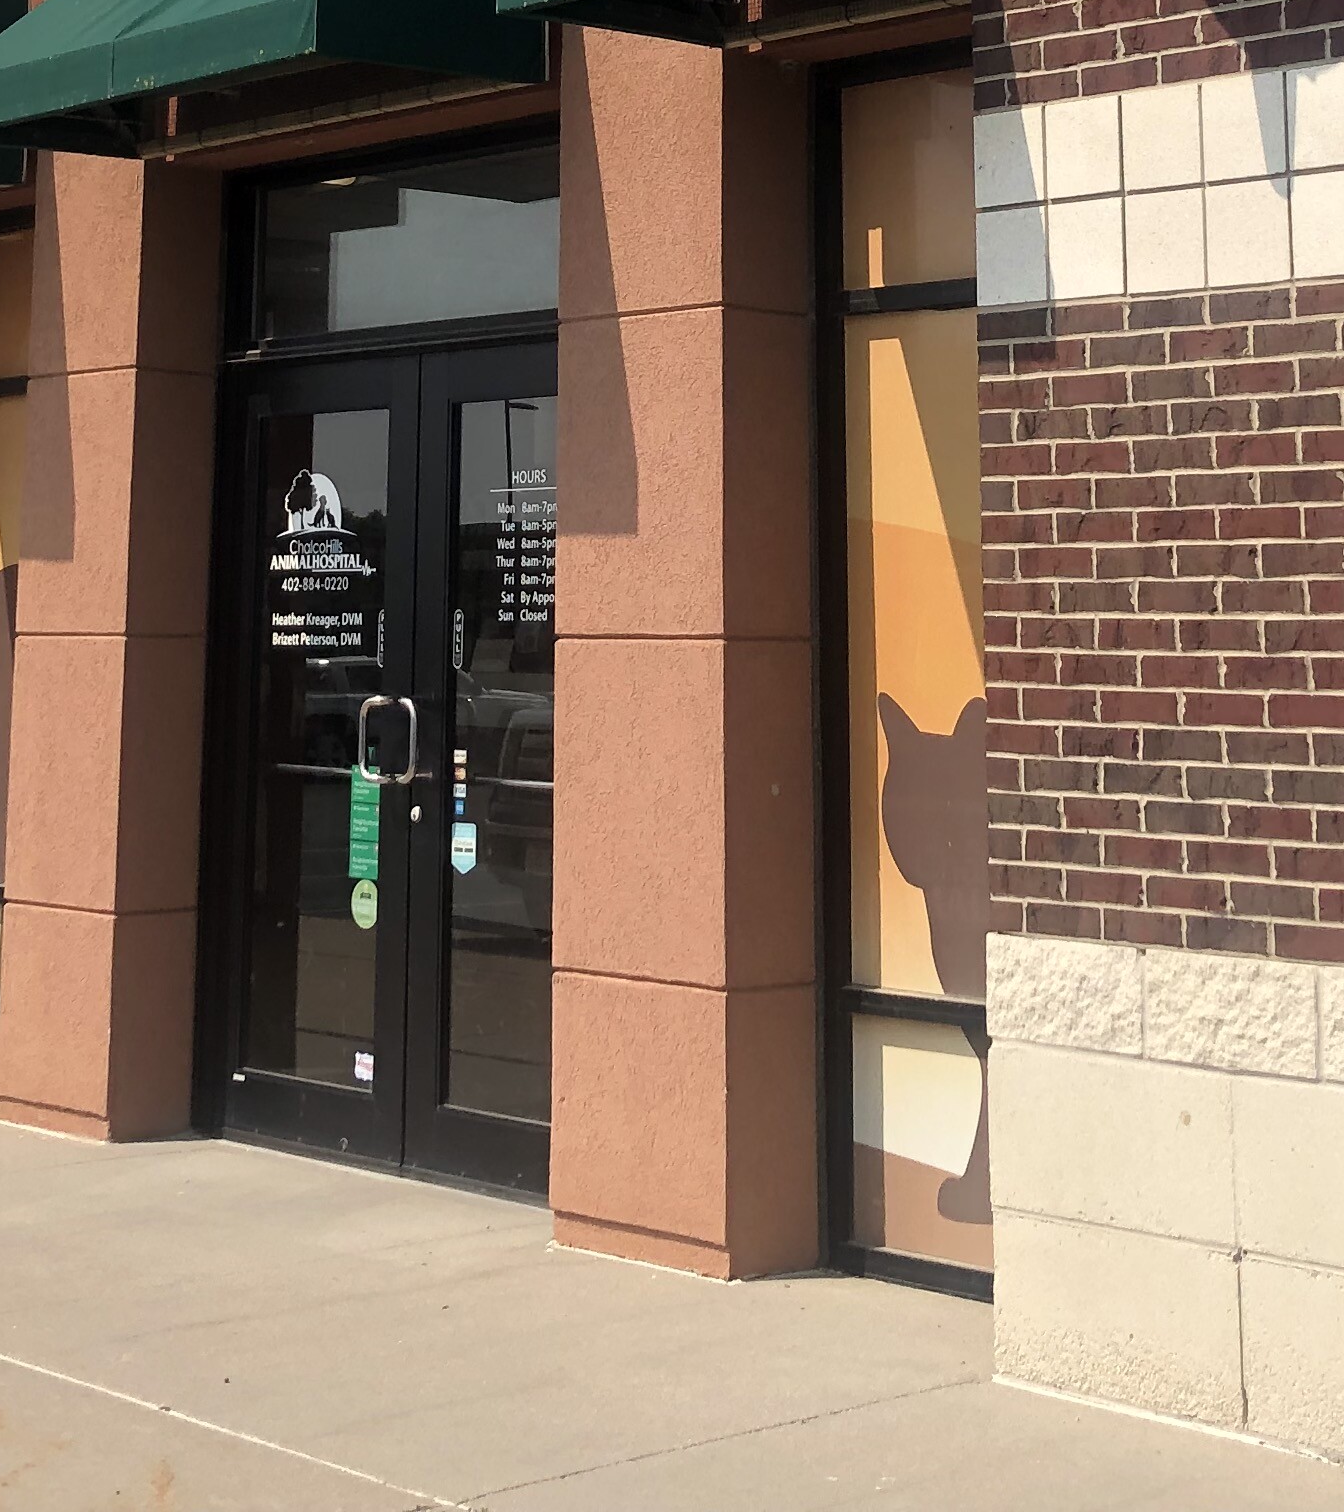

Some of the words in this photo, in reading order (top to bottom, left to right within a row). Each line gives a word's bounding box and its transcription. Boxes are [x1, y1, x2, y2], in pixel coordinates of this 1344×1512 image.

[511, 468, 547, 485] HOURS
[497, 502, 516, 515] Mon
[500, 519, 516, 532] Tue
[289, 538, 343, 556] ChalcoHills
[496, 536, 516, 550] Wed
[495, 554, 515, 567] Thur
[281, 576, 350, 592] 402-884-0220
[503, 572, 515, 586] Fri
[500, 590, 515, 604] Sat
[520, 590, 531, 606] By
[531, 590, 555, 606] Appo
[271, 611, 305, 626] Heather
[305, 612, 341, 630] Kreager,
[341, 612, 363, 626] DVM
[498, 608, 514, 622] Sun
[519, 608, 548, 622] Closed
[271, 631, 299, 646] Brizett
[300, 631, 339, 648] Peterson,
[340, 632, 362, 646] DVM
